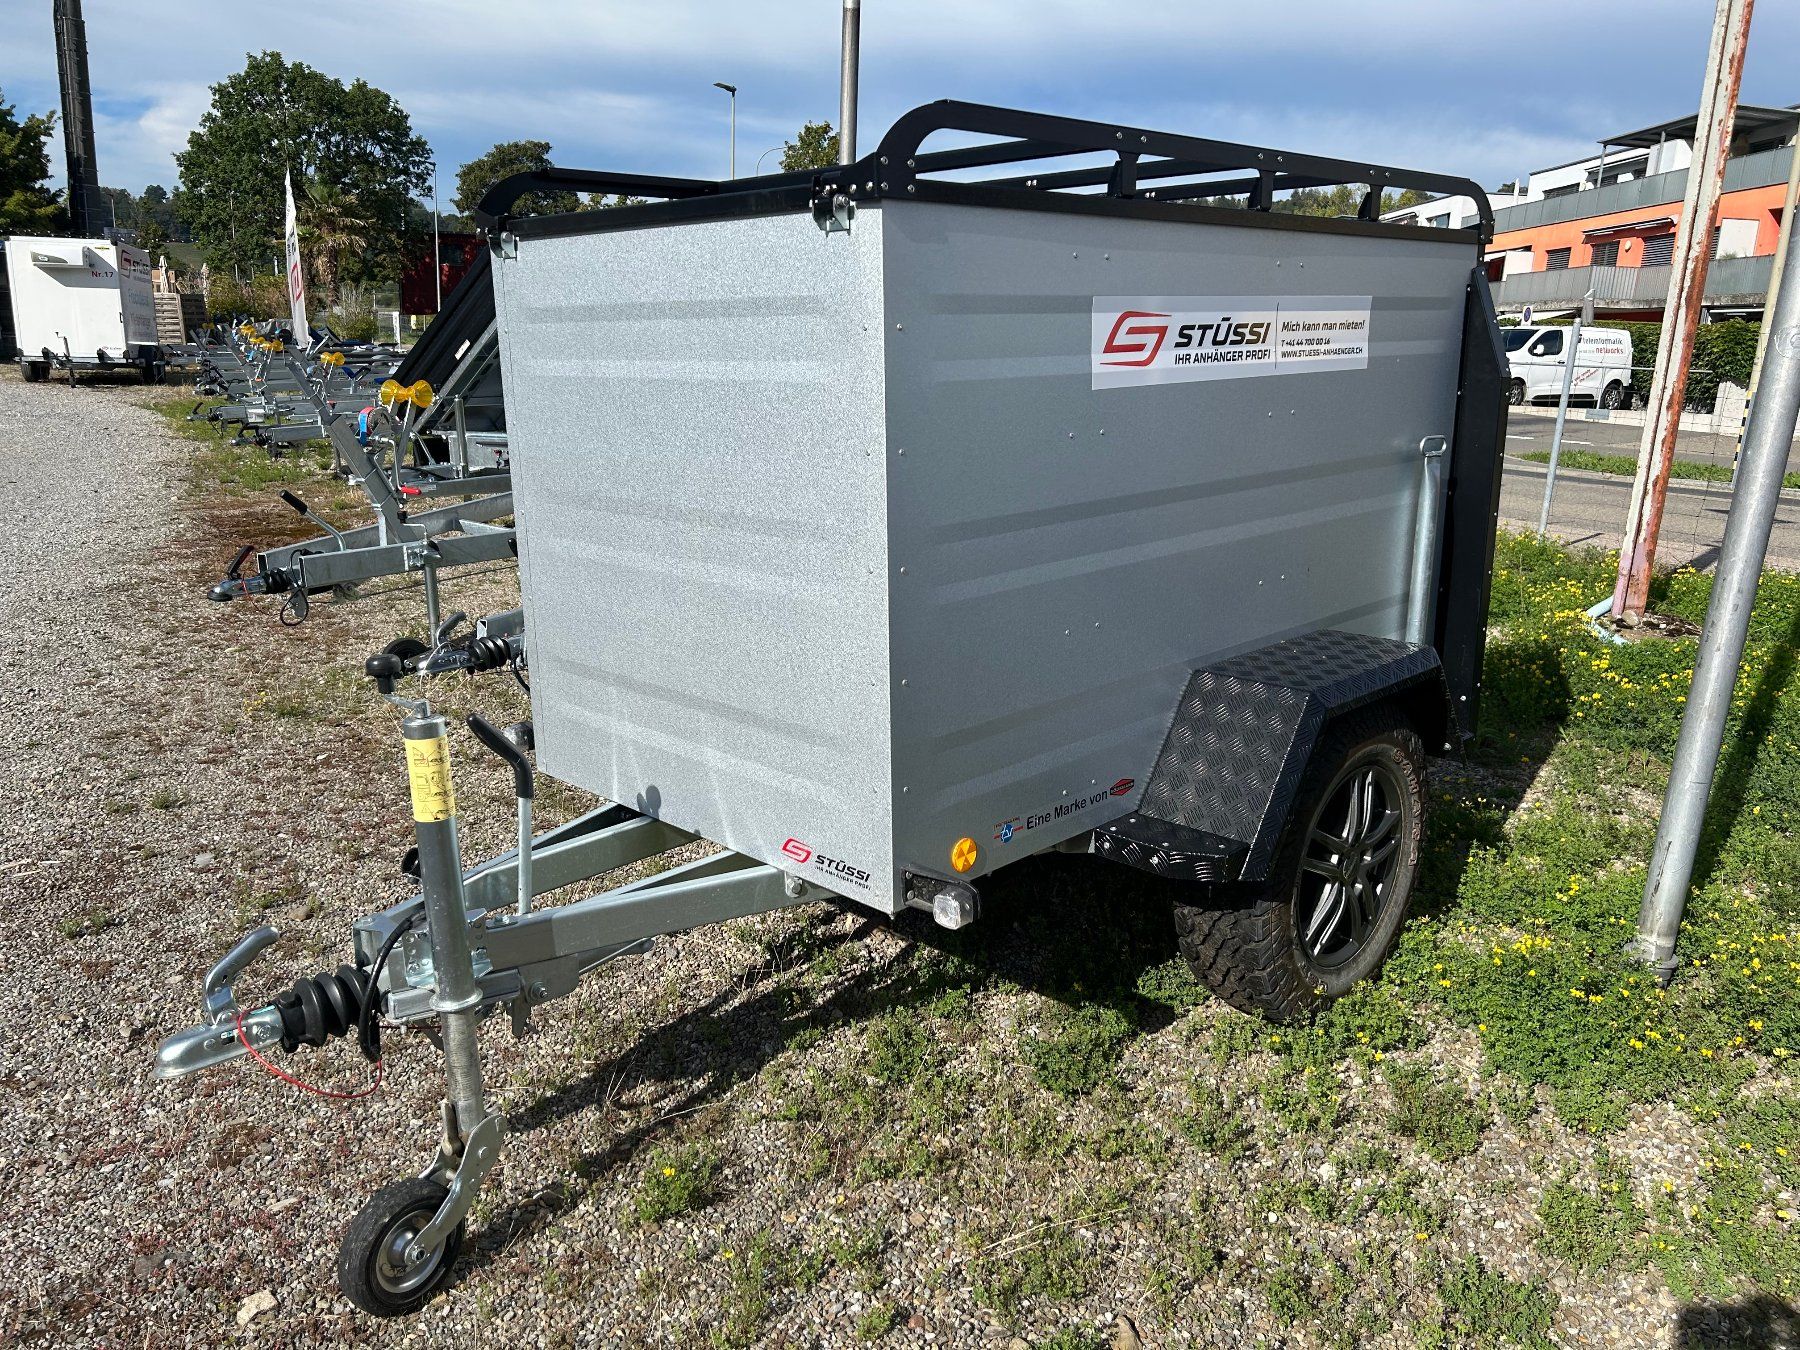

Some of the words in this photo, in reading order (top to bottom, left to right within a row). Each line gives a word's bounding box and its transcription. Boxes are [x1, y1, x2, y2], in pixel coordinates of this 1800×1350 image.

[1174, 317, 1271, 348] STÜSSI
[1281, 321, 1300, 332] Mich
[1302, 321, 1320, 331] kann
[1322, 322, 1337, 331] man
[1339, 320, 1365, 330] mieten!
[1281, 339, 1285, 347] T
[1286, 339, 1295, 347] +41
[1174, 353, 1192, 365] IHR
[1193, 349, 1243, 364] ANHÄNGER
[1245, 349, 1271, 360] PROFI
[1026, 812, 1051, 830] Eine
[1054, 799, 1087, 820] Marke
[1089, 790, 1108, 806] von
[815, 854, 871, 882] STÜSSI
